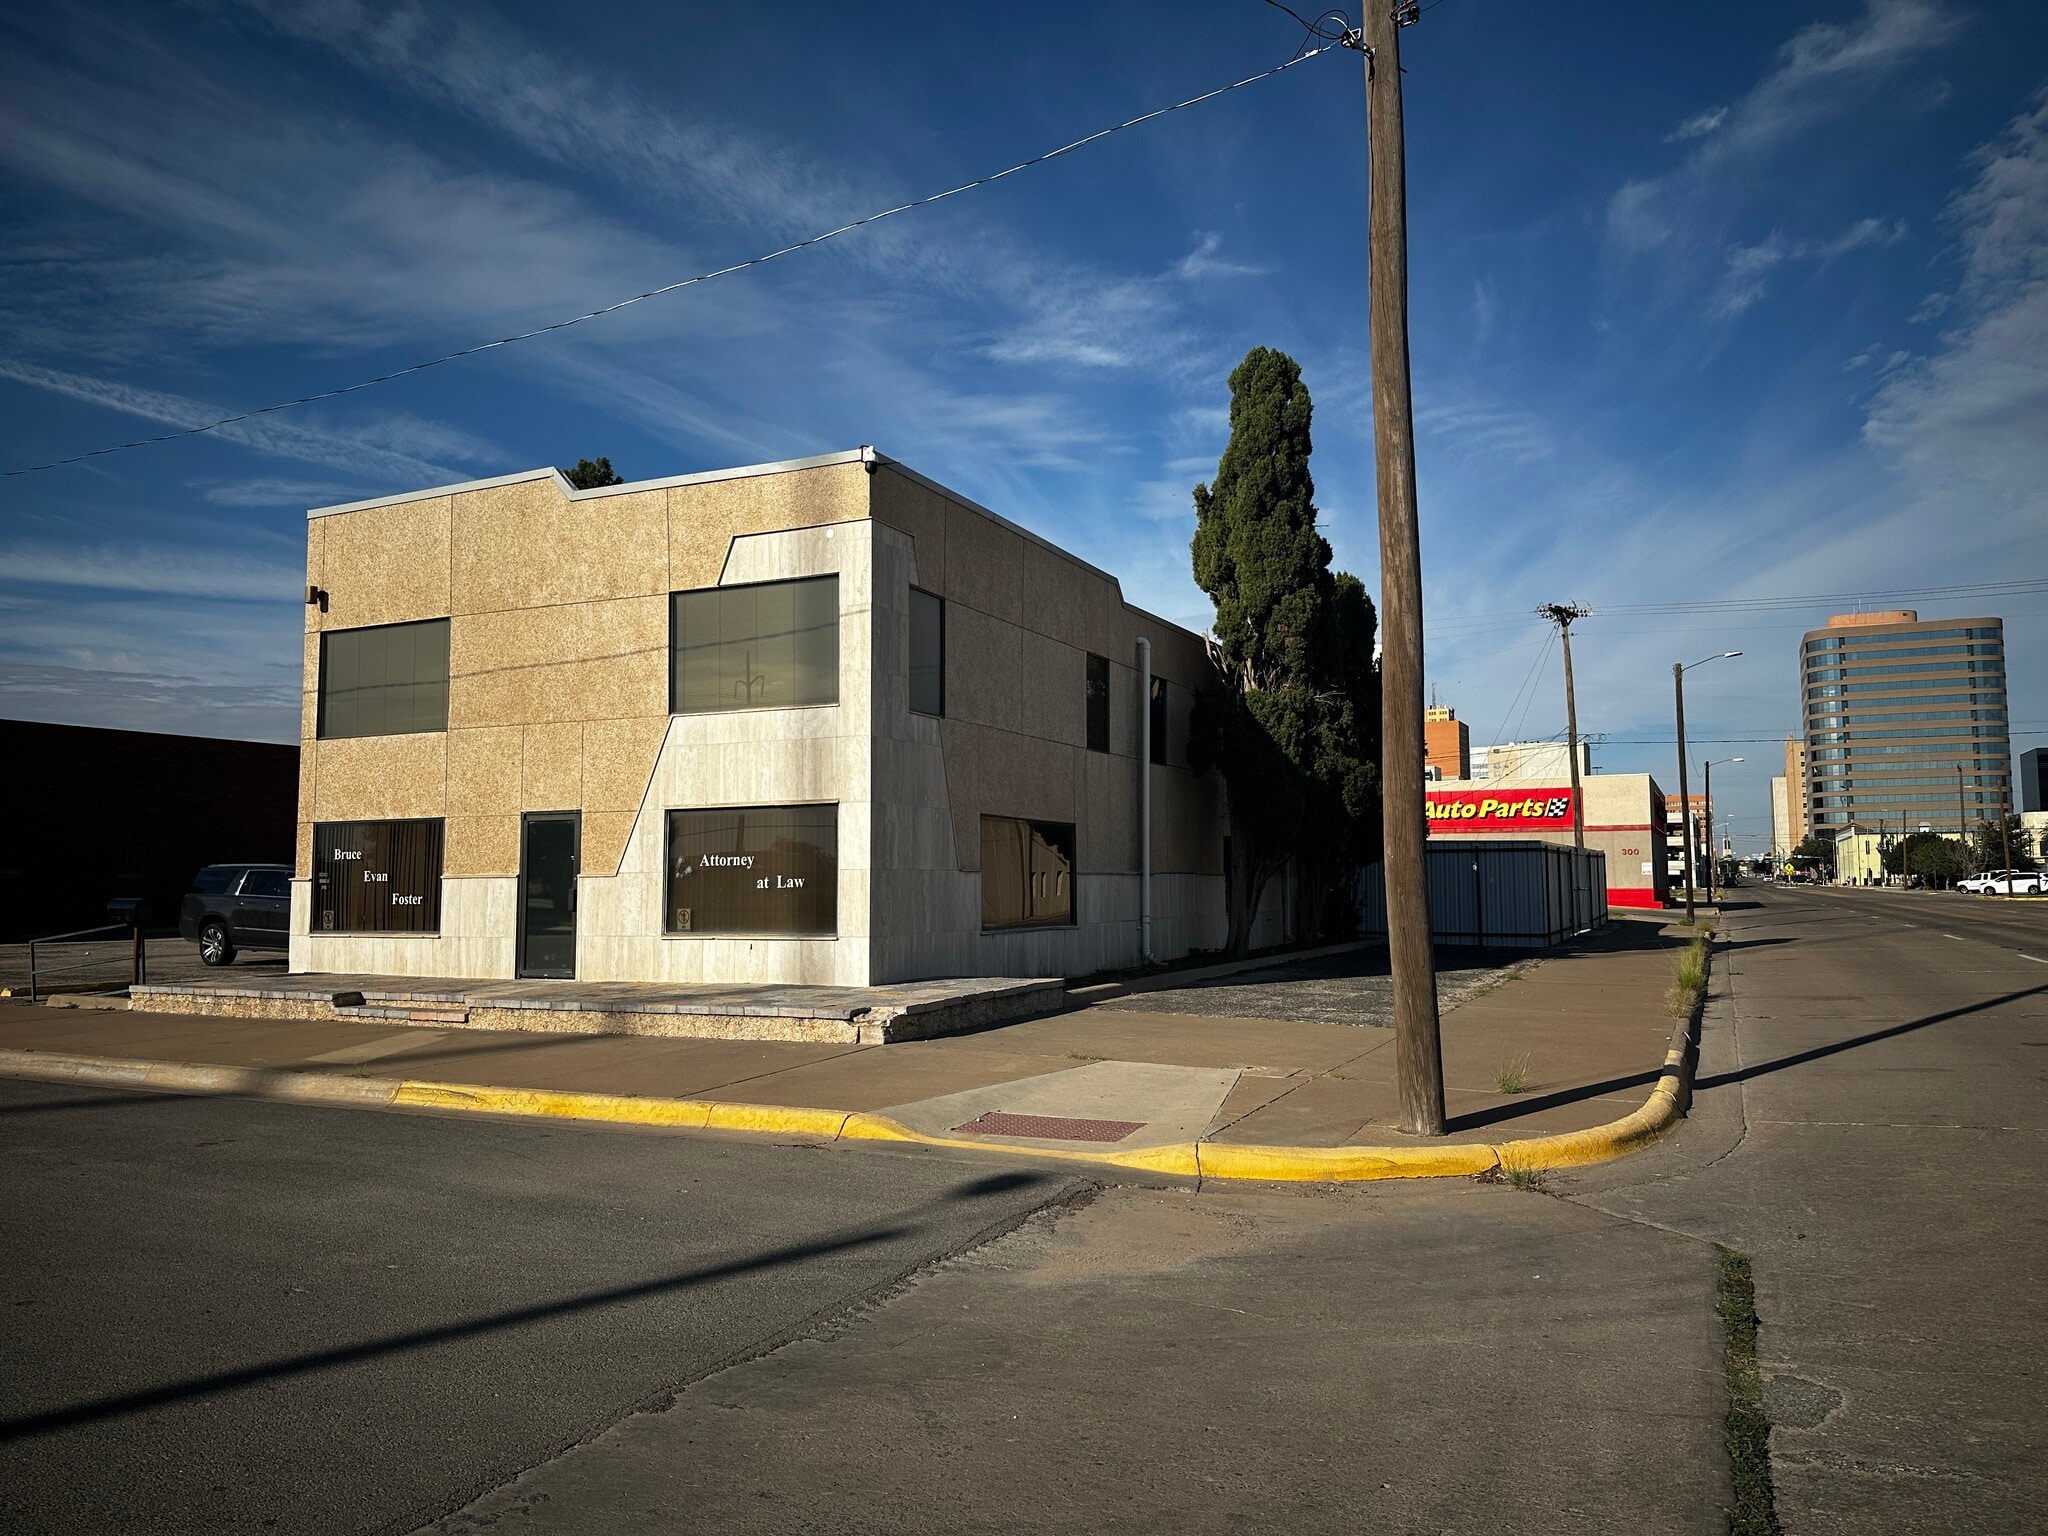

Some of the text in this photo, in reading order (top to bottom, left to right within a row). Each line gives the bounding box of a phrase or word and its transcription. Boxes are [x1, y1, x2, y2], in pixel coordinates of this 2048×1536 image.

[1425, 798, 1545, 819] Auto Parts
[334, 848, 362, 860] Bruce
[1621, 848, 1640, 856] 300
[700, 854, 755, 869] Attorney
[363, 870, 388, 882] Evan
[756, 875, 805, 889] at Law
[392, 893, 423, 905] Foster
